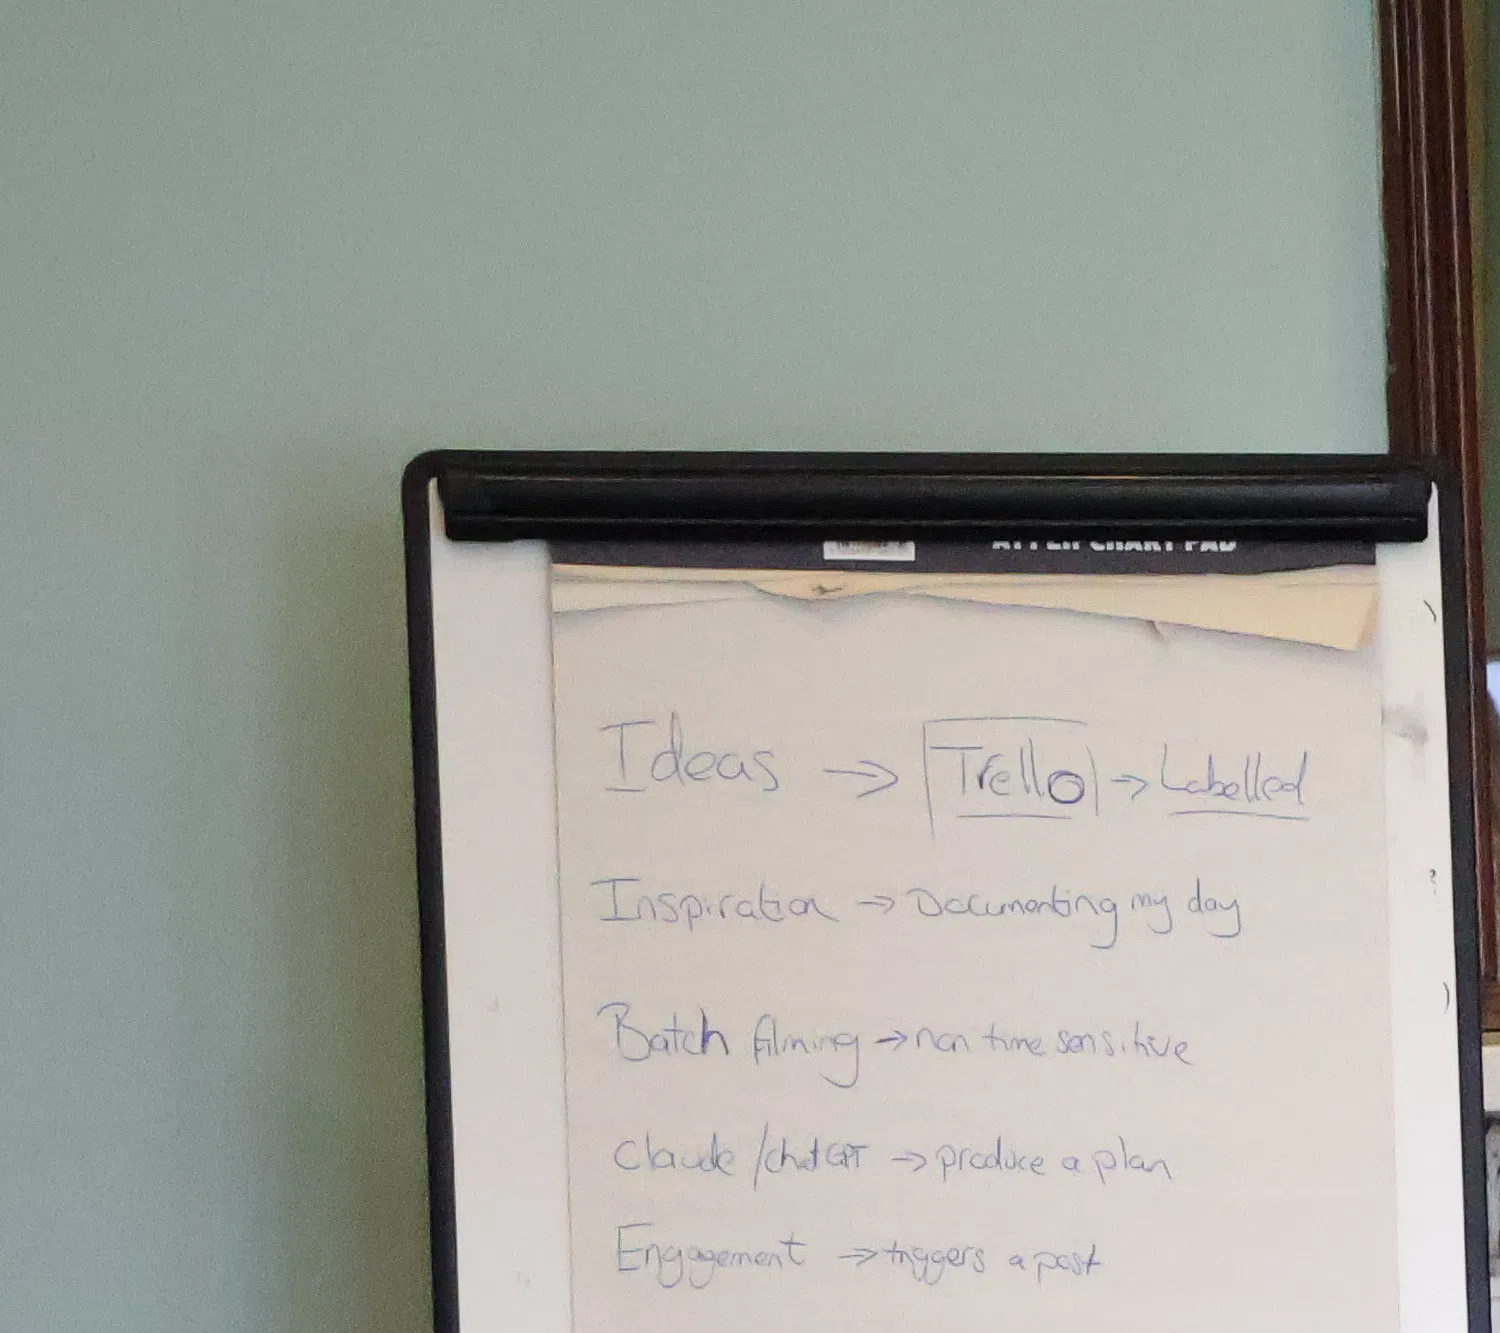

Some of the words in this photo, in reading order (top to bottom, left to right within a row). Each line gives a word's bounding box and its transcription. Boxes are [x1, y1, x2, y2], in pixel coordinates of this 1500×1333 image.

[601, 712, 778, 792] Ideas
[931, 737, 1086, 806] Trello
[1160, 743, 1308, 806] Labelled
[590, 878, 840, 932] Inspiration
[906, 889, 1119, 949] Documenting
[1132, 893, 1175, 936] my
[1188, 879, 1242, 938] day
[597, 1002, 730, 1062] Batch
[915, 1027, 970, 1052] non
[981, 1023, 1047, 1056] time
[614, 1130, 736, 1176] Claude
[936, 1136, 1047, 1183] produce
[1061, 1156, 1081, 1175] a
[1091, 1133, 1173, 1186] plan
[615, 1223, 808, 1290] Engagement
[1008, 1253, 1026, 1272] a
